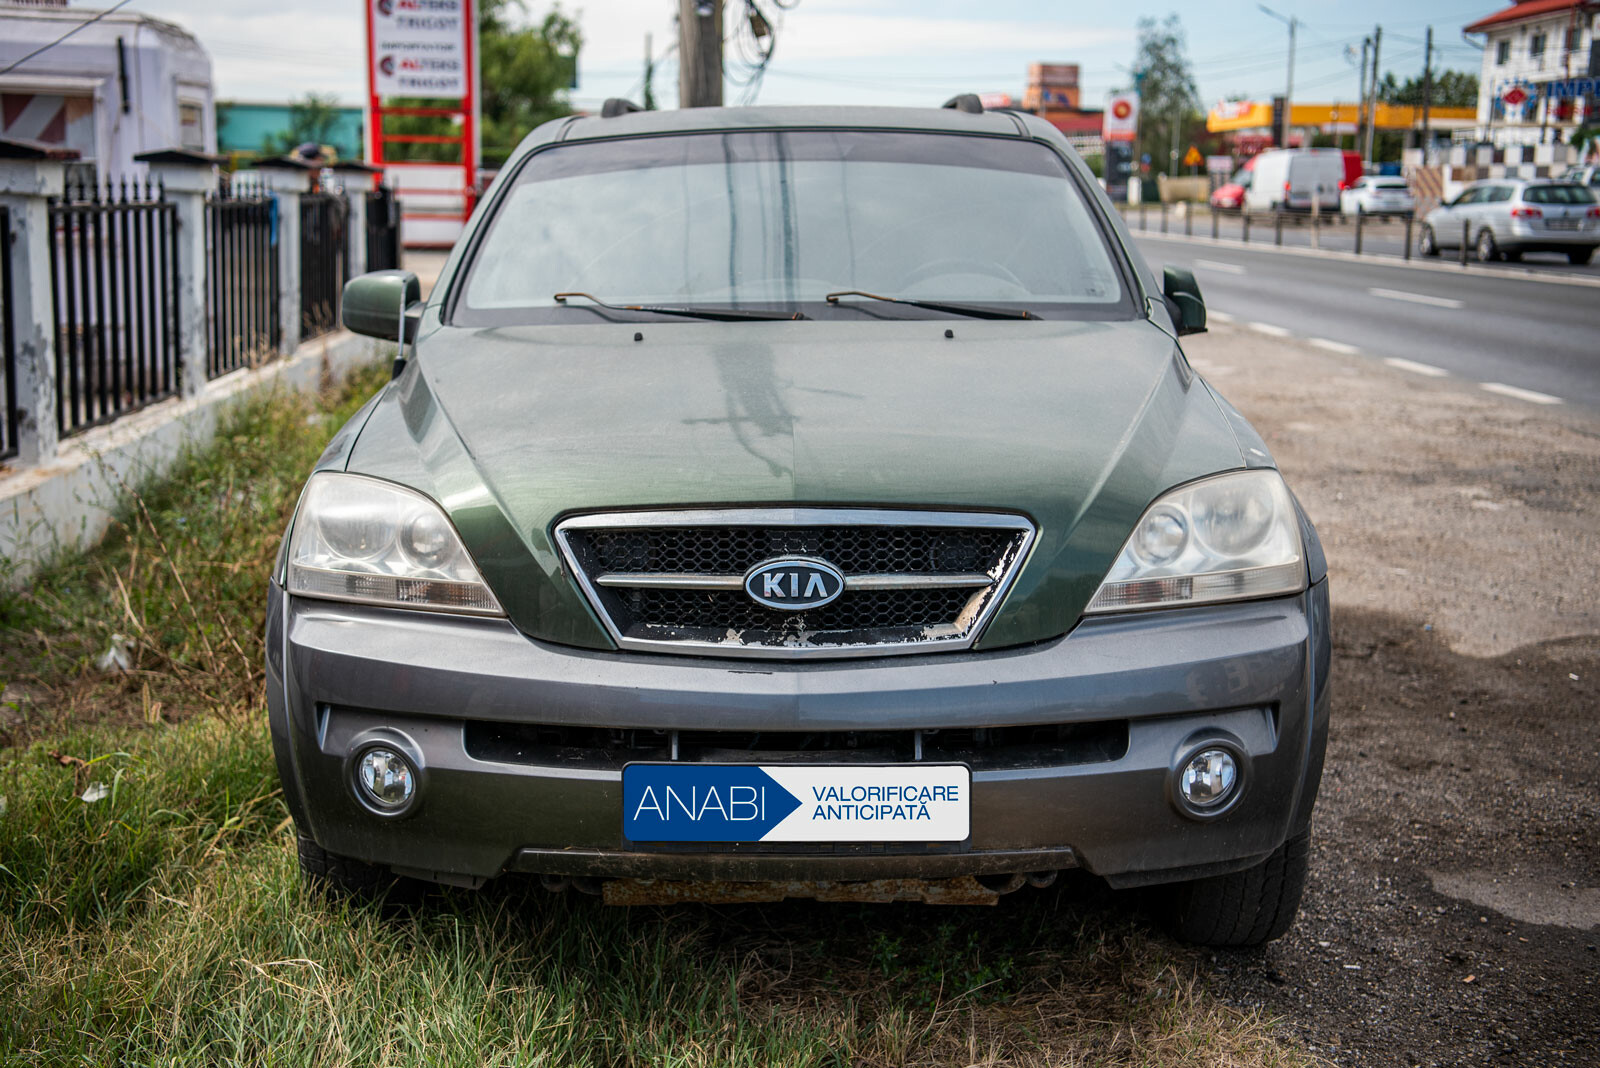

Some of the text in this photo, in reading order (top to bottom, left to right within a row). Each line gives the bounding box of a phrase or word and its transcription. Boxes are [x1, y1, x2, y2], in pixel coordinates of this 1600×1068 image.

[762, 572, 828, 598] KIA
[633, 786, 765, 821] ANABI
[812, 786, 959, 802] VALORIFICARE
[812, 801, 931, 821] ANTICIPATĂ
